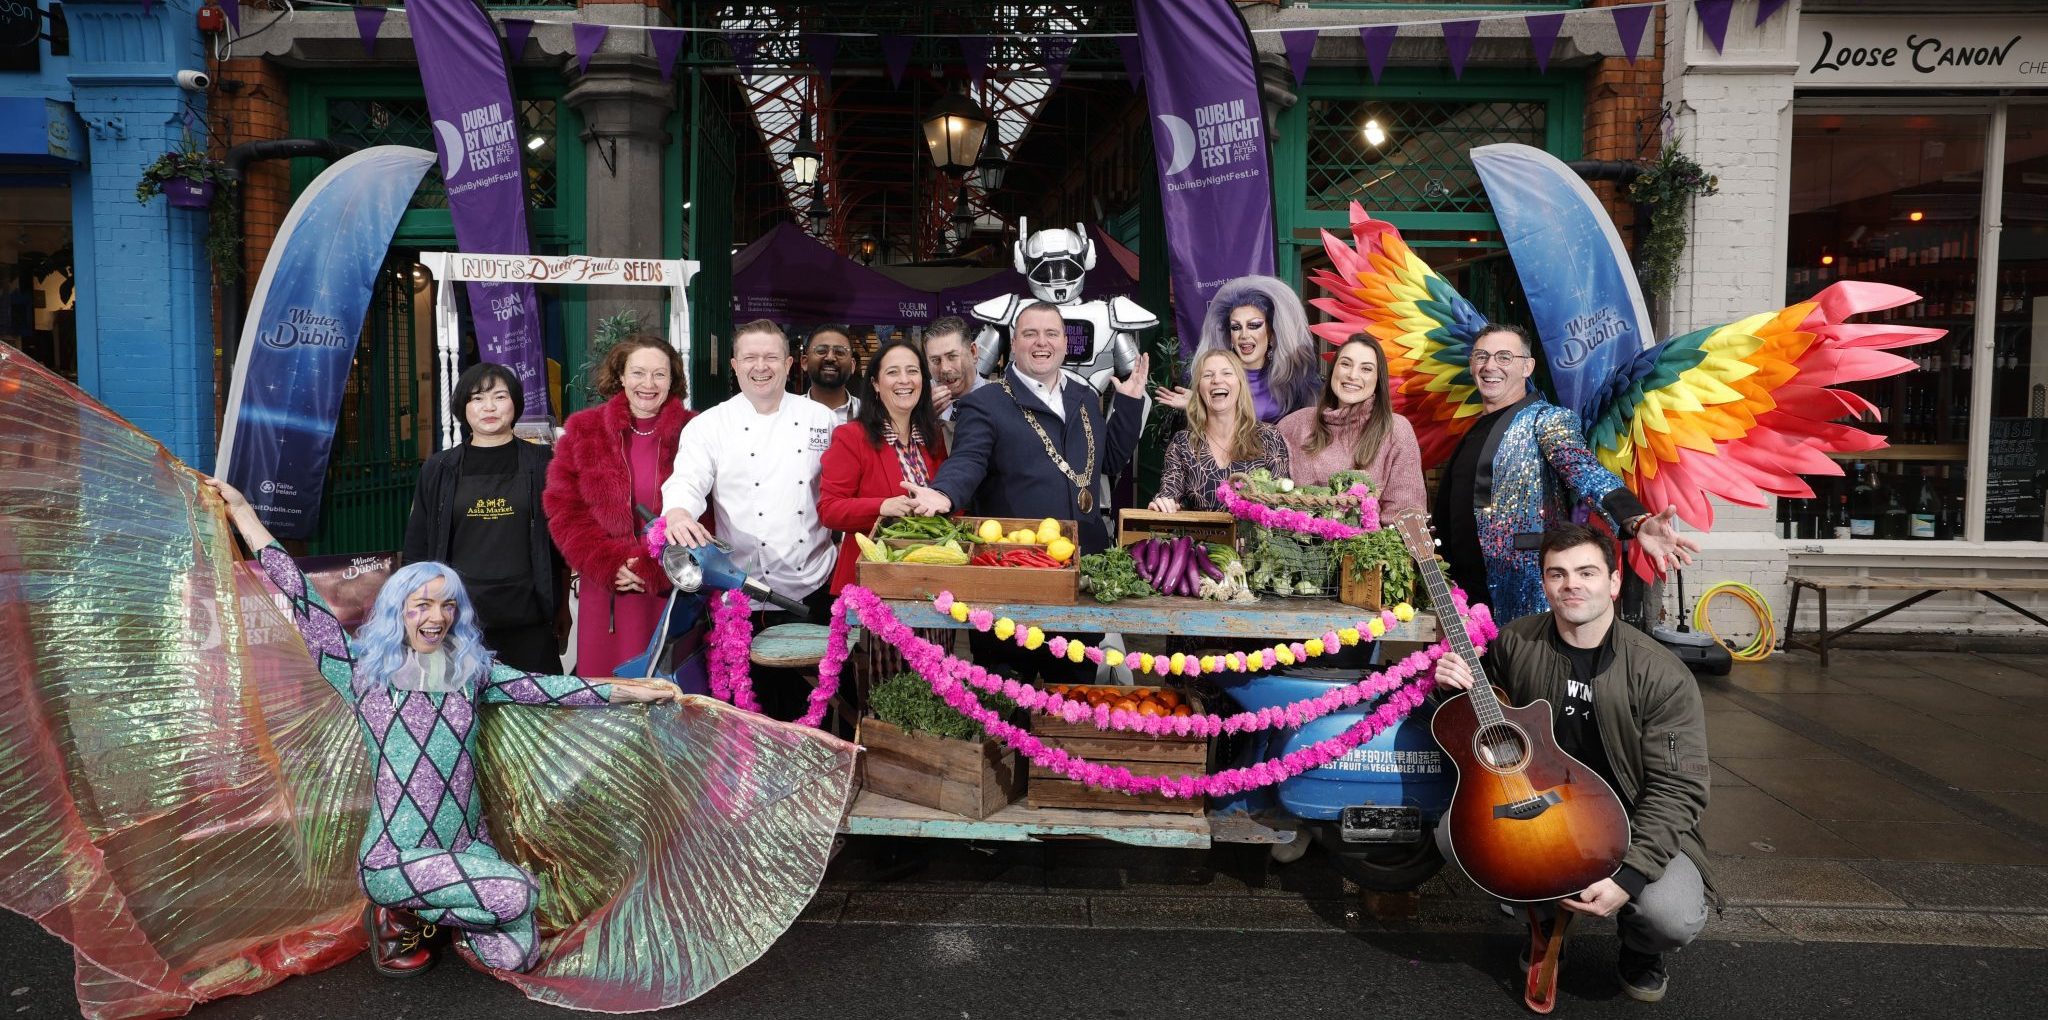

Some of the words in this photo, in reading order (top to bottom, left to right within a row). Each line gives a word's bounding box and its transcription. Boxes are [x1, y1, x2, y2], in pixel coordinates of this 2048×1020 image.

[461, 103, 502, 132] DUBLIN
[1195, 99, 1246, 128] DUBLIN
[464, 129, 480, 152] BY
[480, 120, 514, 148] NIGHT
[1198, 126, 1216, 148] BY
[1218, 117, 1259, 144] NIGHT
[495, 141, 512, 152] ALIVE
[1232, 139, 1255, 150] ALIVE
[1233, 145, 1258, 156] AFTER
[468, 147, 495, 172] FEST
[1201, 143, 1232, 169] FEST
[1234, 154, 1252, 163] FIVE
[448, 170, 519, 196] DublinByNightFest.ie
[1167, 169, 1260, 191] DublinByNightFest.ie
[462, 257, 525, 280] NUTS
[525, 257, 572, 281] Dried
[623, 261, 663, 282] SEEDS
[289, 308, 341, 327] Winter
[900, 310, 928, 318] TOWN
[1564, 306, 1609, 337] Winter
[261, 321, 348, 350] Dublin
[1555, 319, 1633, 369] Dublin
[809, 437, 828, 445] SOLE
[486, 505, 513, 513] Market
[342, 562, 384, 580] Dublin
[351, 556, 377, 566] Winter
[1339, 761, 1361, 771] FRUIT
[1371, 762, 1416, 773] VEGETABLES
[1416, 764, 1426, 774] IN
[1427, 764, 1442, 774] ASIA
